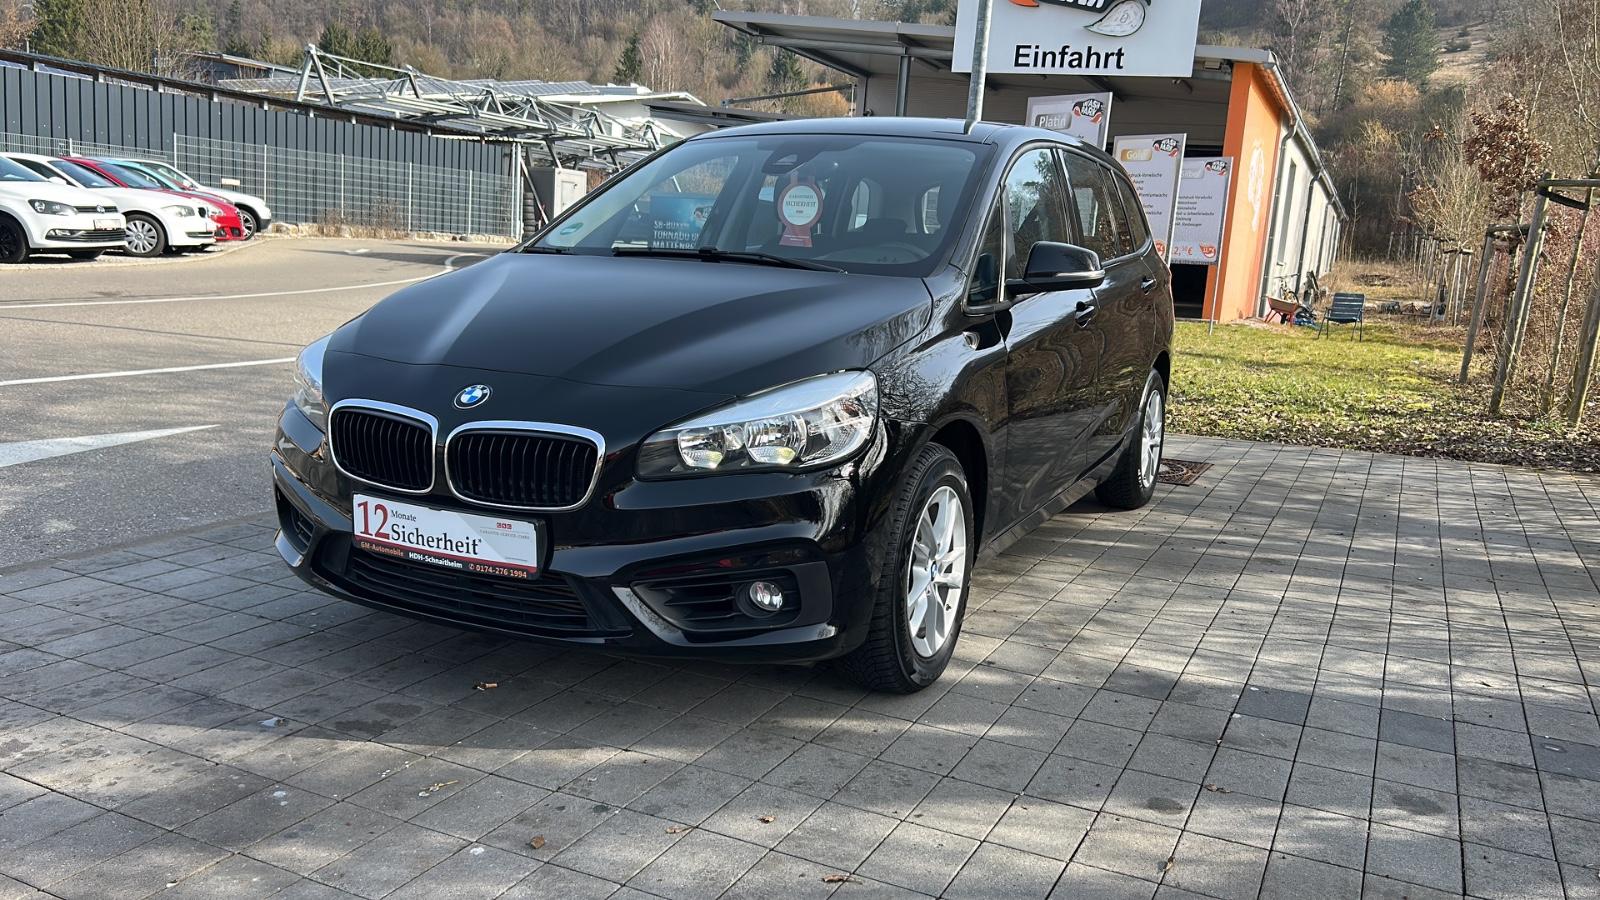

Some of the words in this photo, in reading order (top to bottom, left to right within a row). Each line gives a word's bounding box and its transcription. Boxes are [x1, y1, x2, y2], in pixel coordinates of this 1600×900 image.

[1014, 44, 1125, 70] Einfahrt
[1039, 115, 1066, 128] Platin
[357, 500, 390, 541] 12
[391, 509, 417, 522] Monate
[408, 551, 463, 570] HDH-Schnaitheim
[475, 564, 508, 577] 0174-276
[510, 569, 527, 579] 1994
